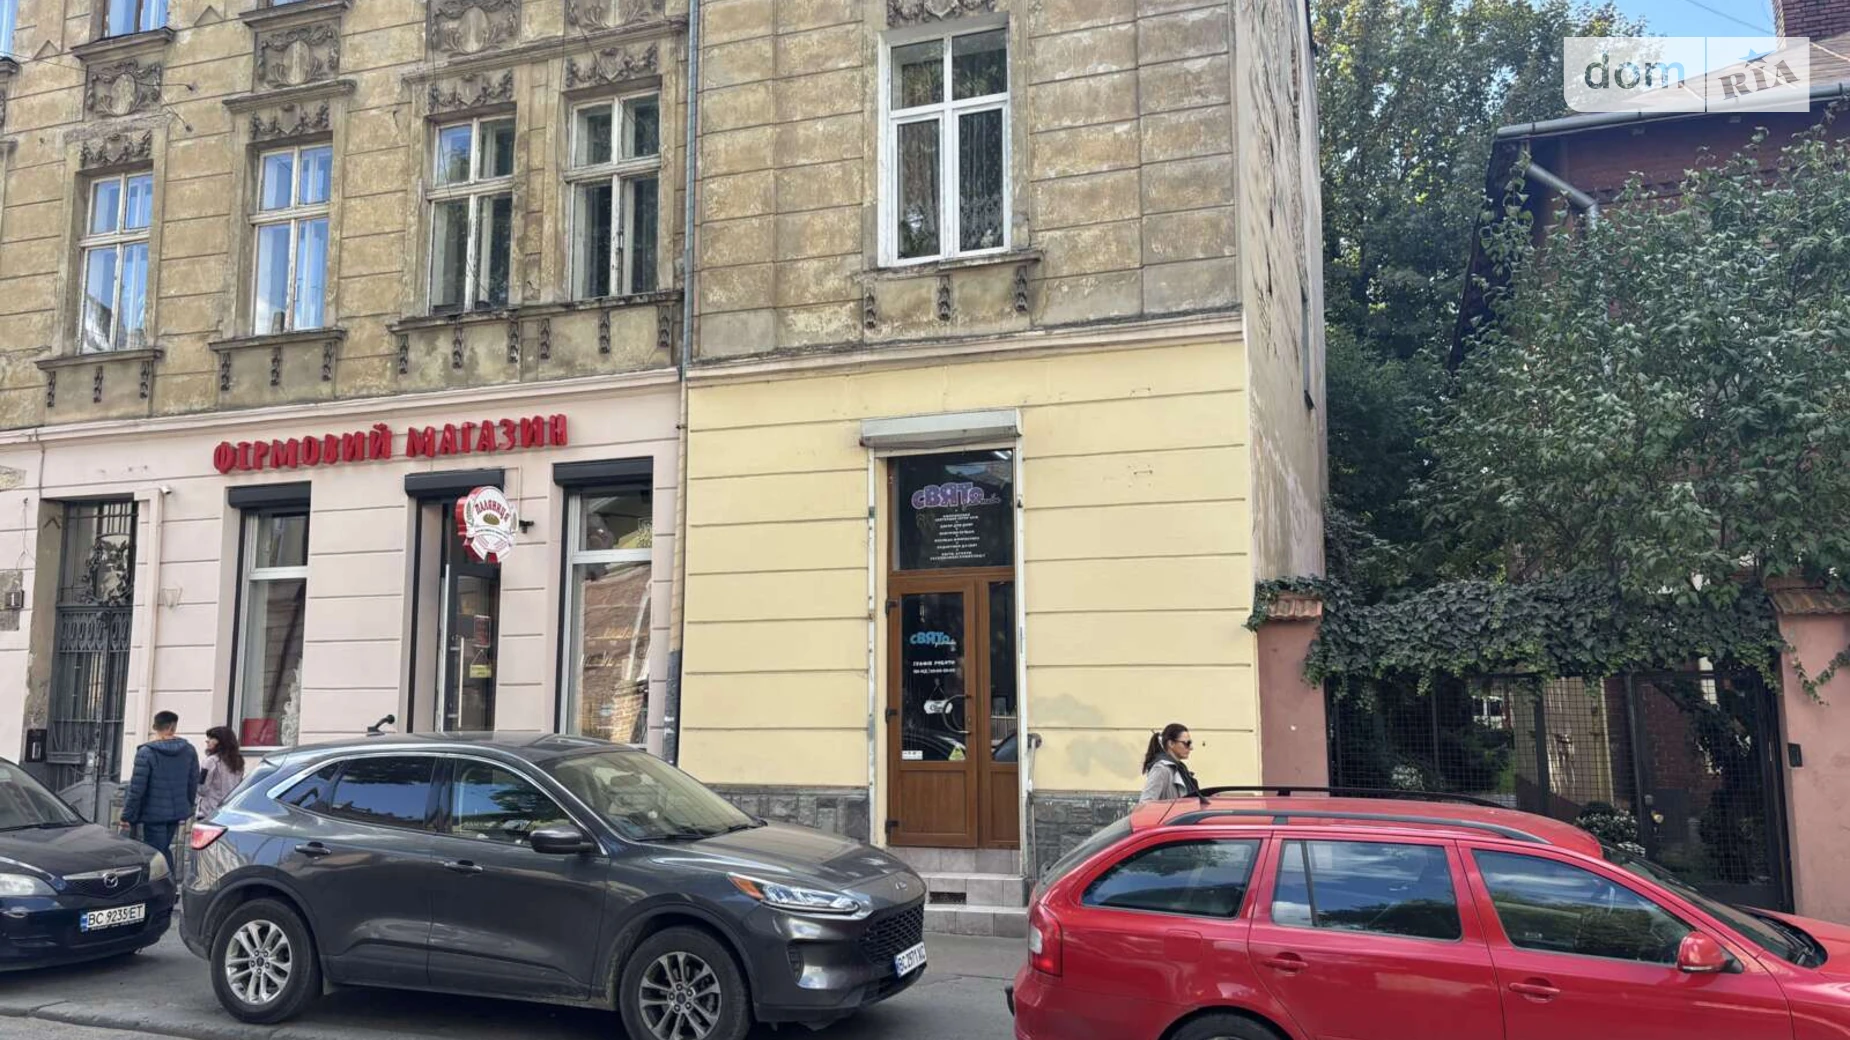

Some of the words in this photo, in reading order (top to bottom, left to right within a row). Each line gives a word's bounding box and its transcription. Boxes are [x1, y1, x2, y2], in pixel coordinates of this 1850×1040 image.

[213, 423, 393, 474] ФІРМОВИЙ
[406, 413, 568, 458] МАГАЗИН
[88, 912, 104, 926] BC
[106, 908, 128, 924] 9235
[130, 904, 144, 919] ET
